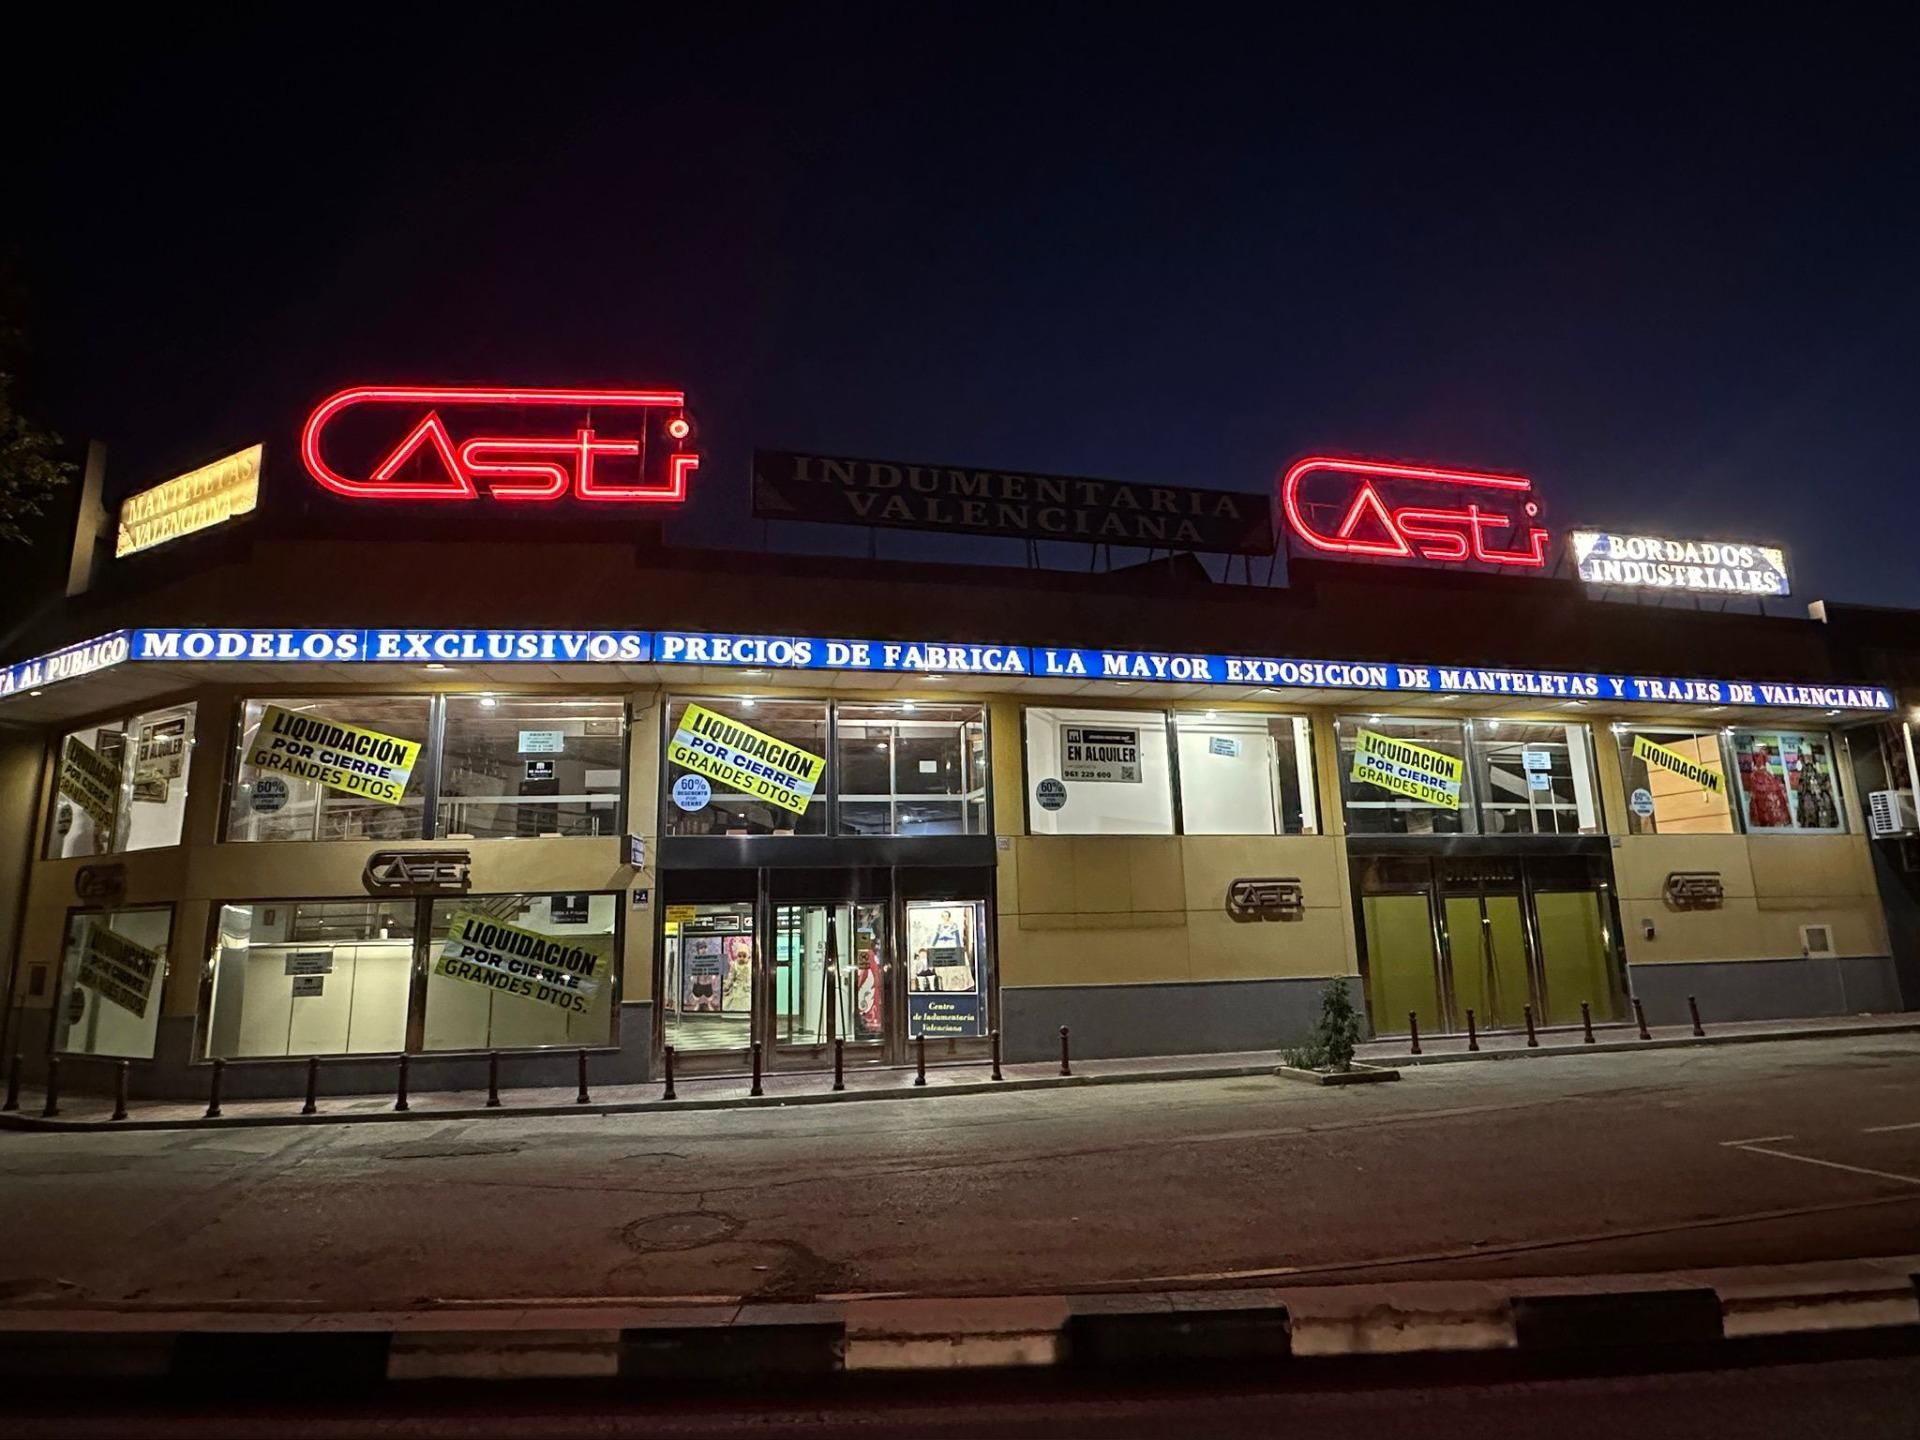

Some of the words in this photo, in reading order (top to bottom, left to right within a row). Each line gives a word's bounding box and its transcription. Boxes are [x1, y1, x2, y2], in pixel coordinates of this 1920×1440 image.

[127, 450, 253, 525] MANTELETAS
[793, 456, 1241, 521] INDUMENTARIA
[135, 493, 233, 548] VALENCIANA
[844, 490, 1204, 544] VALENCIANA
[1607, 534, 1755, 570] BORDADOS
[1590, 559, 1780, 592] INDUSTRIALES
[19, 664, 42, 688] AL
[46, 636, 128, 680] PUBLICO
[142, 633, 358, 659] MODELOS
[378, 633, 642, 661] EXCLUSIVOS
[662, 636, 811, 665] PRECIOS
[826, 643, 870, 666] DE
[883, 645, 1025, 673] FABRICA
[1046, 651, 1087, 674] LA
[1102, 653, 1212, 681] MAYOR
[1226, 659, 1387, 687] EXPOSICION
[1397, 667, 1431, 688] DE
[1438, 669, 1599, 696] MANTELETAS
[1609, 678, 1625, 697] Y
[1634, 680, 1722, 702] TRAJES
[1728, 683, 1756, 703] DE
[1758, 685, 1890, 709] VALENCIANA
[271, 737, 313, 760] POR
[318, 753, 392, 779] CIERRE
[272, 713, 408, 766] LIQUIDACIÓN
[692, 712, 815, 779] LIQUIDACIÓN
[1068, 746, 1081, 761] EN
[1085, 746, 1136, 763] ALQUILER
[1365, 736, 1455, 778] LIQUIDACIÓN
[254, 750, 342, 785] GRANDES
[346, 773, 398, 801] DTOS.
[674, 746, 754, 788] GRANDES
[757, 780, 803, 811] DTOS.
[681, 778, 707, 790] 60%
[690, 737, 728, 761] POR
[733, 754, 799, 790] CIERRE
[1366, 756, 1394, 773] POR
[1398, 767, 1448, 790] CIERRE
[1640, 742, 1719, 790] LIQUIDACIÓN
[257, 781, 285, 793] 60%
[1041, 782, 1063, 793] 60%
[1358, 766, 1418, 796] GRANDES
[1420, 786, 1457, 807] DTOS.
[460, 946, 503, 967] POR
[508, 959, 581, 989] CIERRE
[462, 918, 598, 977] LIQUIDACIÓN
[444, 959, 531, 996] GRANDES
[537, 985, 588, 1014] DTOS.
[928, 1001, 955, 1010] Centro
[913, 1012, 922, 1021] de
[923, 1012, 975, 1021] Indumentaria
[922, 1023, 962, 1032] Valenciana
